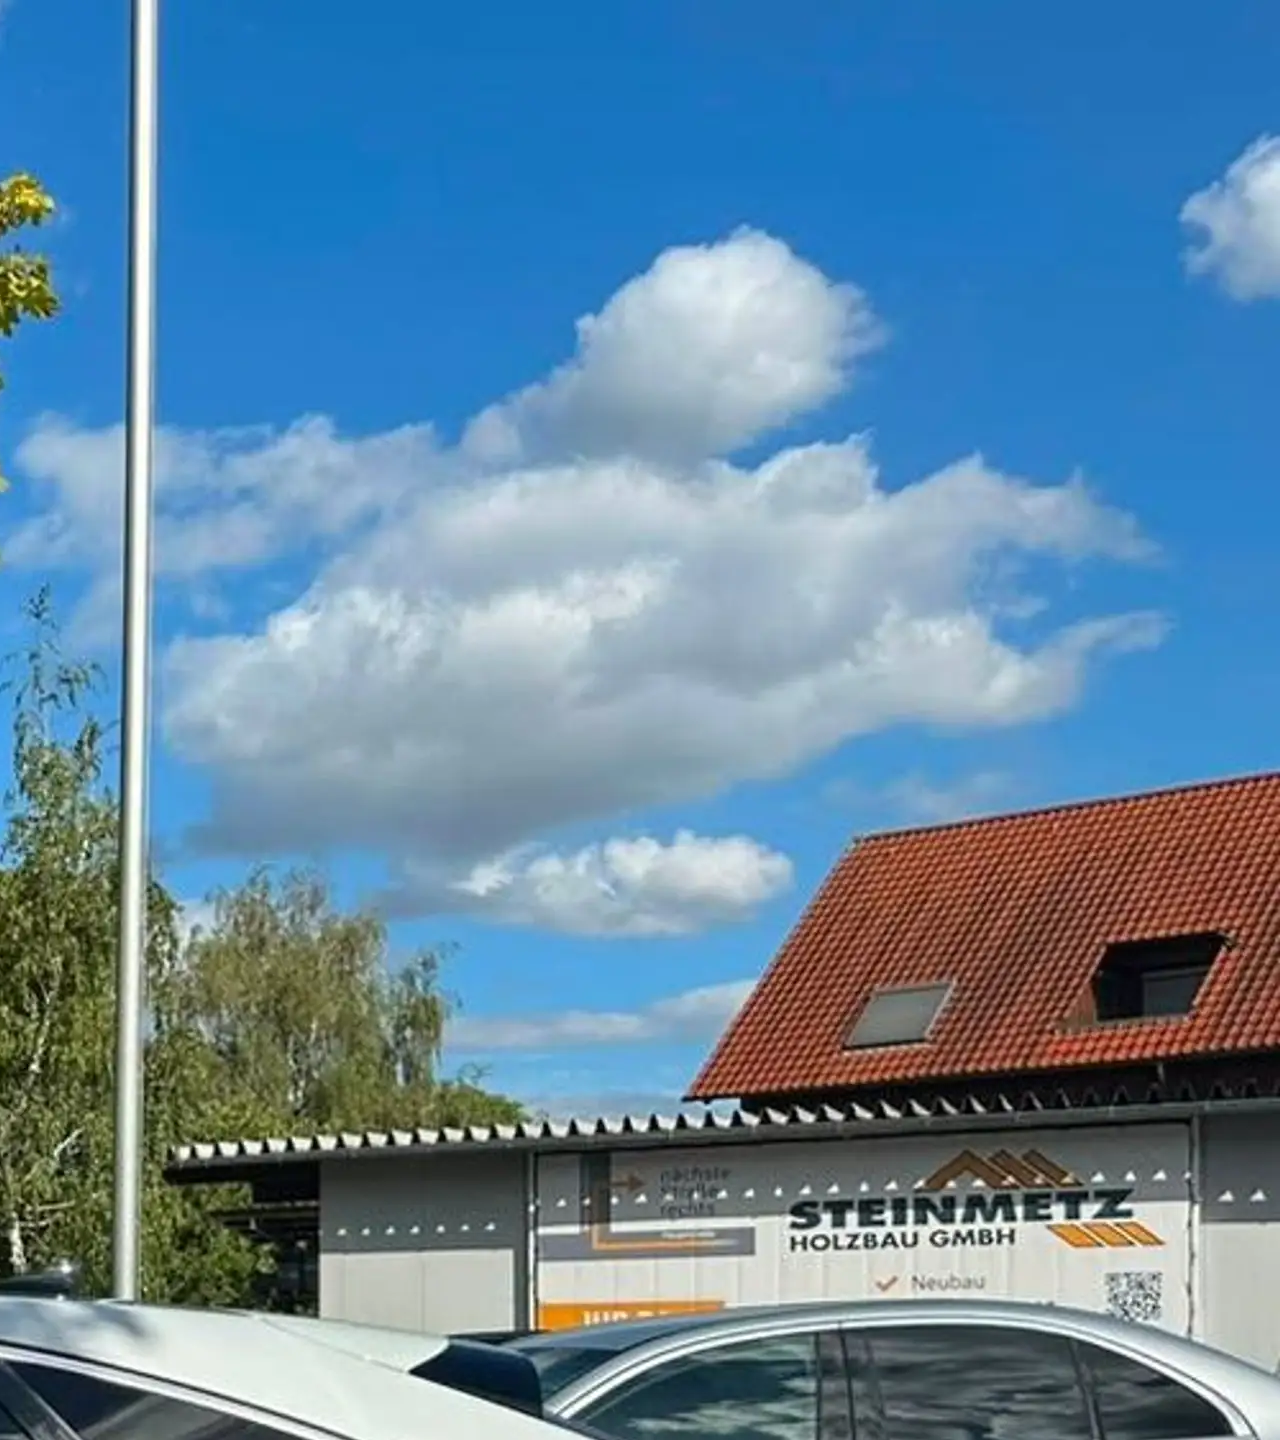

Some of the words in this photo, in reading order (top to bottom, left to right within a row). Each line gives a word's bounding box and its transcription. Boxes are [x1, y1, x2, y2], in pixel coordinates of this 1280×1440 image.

[789, 1188, 1137, 1231] STEINMETZ
[790, 1231, 919, 1253] HOLZBAU
[929, 1228, 1016, 1249] GMBH
[911, 1274, 986, 1292] Neubau
